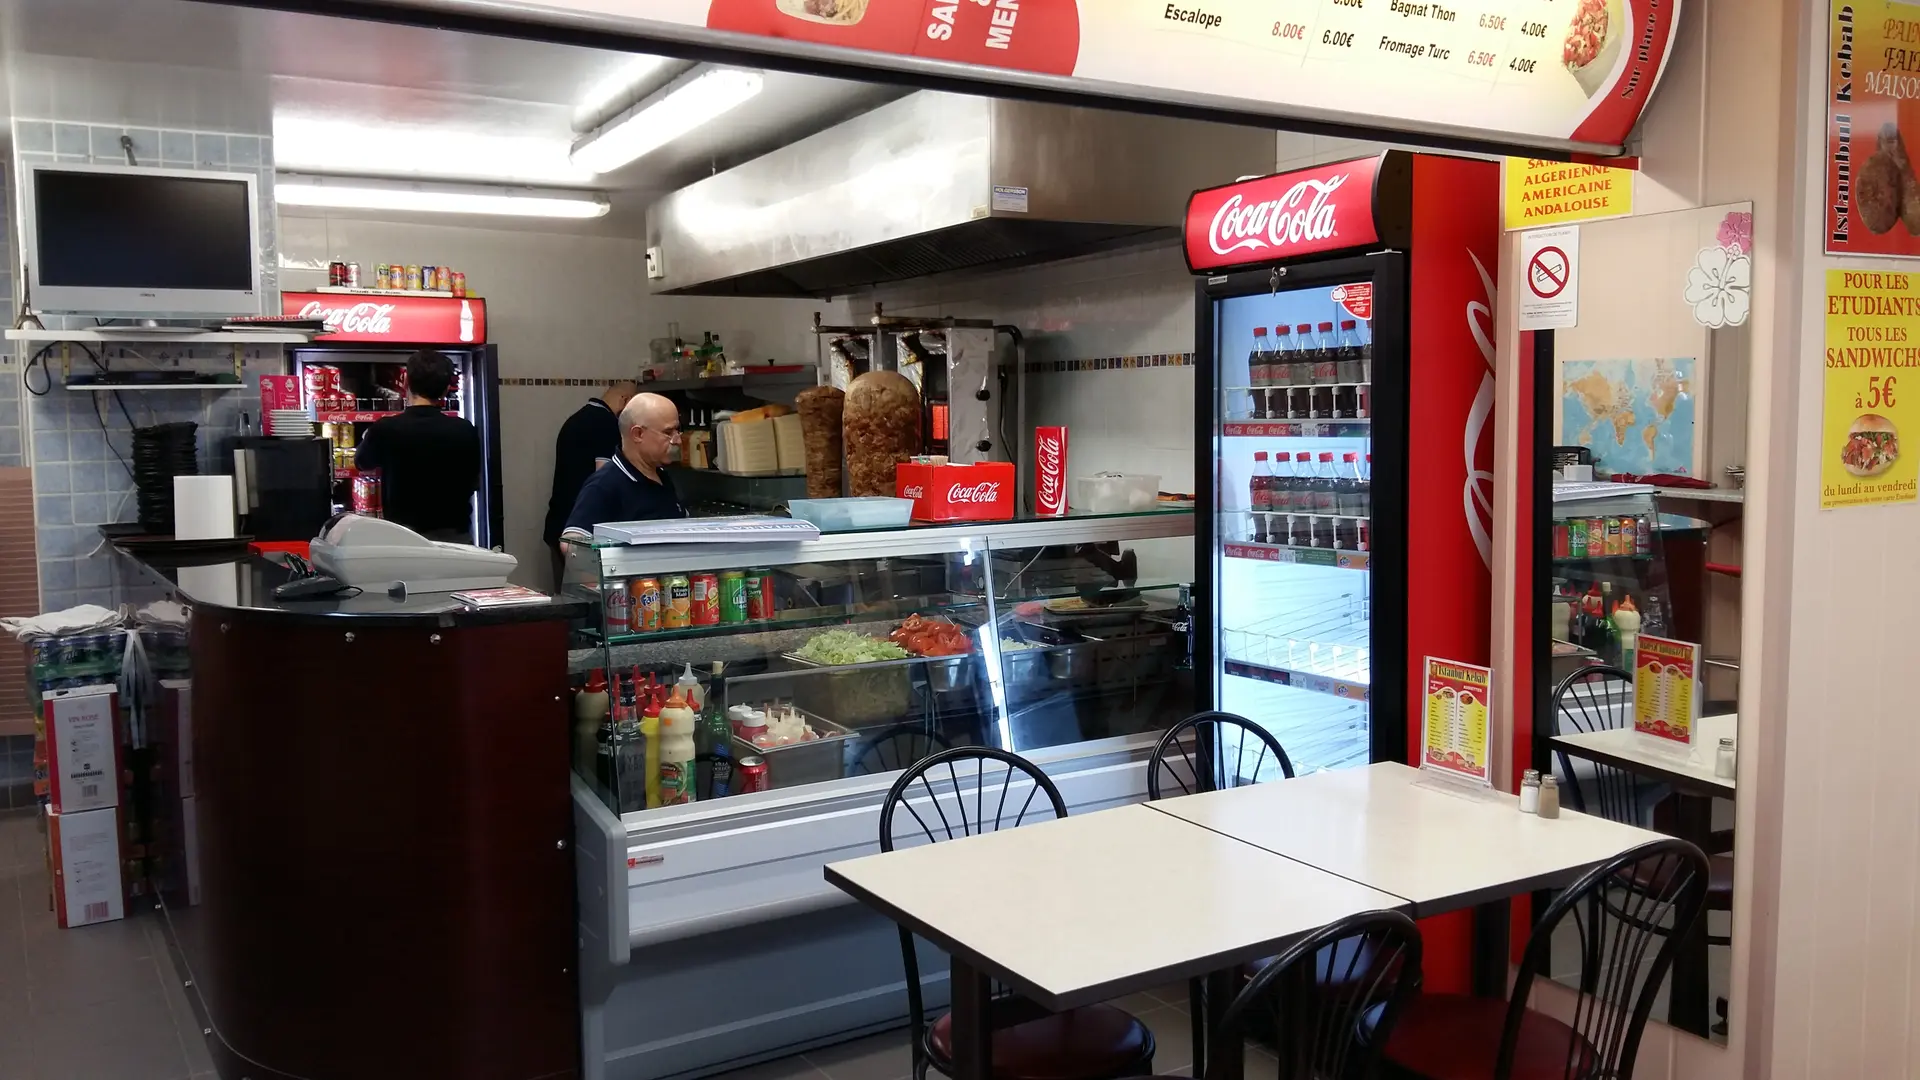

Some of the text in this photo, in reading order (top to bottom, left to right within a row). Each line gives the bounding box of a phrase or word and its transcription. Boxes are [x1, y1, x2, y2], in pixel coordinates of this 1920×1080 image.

[926, 0, 959, 41] SA
[1390, 0, 1456, 22] Bagnat Thon
[1164, 3, 1355, 48] Escalope 8.00€ 6.00€
[1478, 13, 1548, 38] 6.50€ 4.00€
[1378, 36, 1537, 74] Fromage Turc 6.50€ 4.00€
[1620, 65, 1642, 99] Sur
[1637, 12, 1657, 64] place
[1836, 4, 1854, 104] Kebab
[1865, 70, 1920, 99] MAISO
[1524, 165, 1610, 186] ALGERIENNE
[1521, 179, 1612, 202] AMERICAINE
[1208, 173, 1350, 255] Coca-Cola
[1524, 196, 1610, 218] ANDALOUSE
[1843, 272, 1909, 290] POUR LES
[1846, 326, 1907, 342] TOUS LES
[1855, 375, 1897, 409] à 5€
[1037, 434, 1060, 509] Coca-Cola
[947, 481, 1000, 504] Coca-Cola
[1823, 479, 1917, 497] du lundi au vendredi
